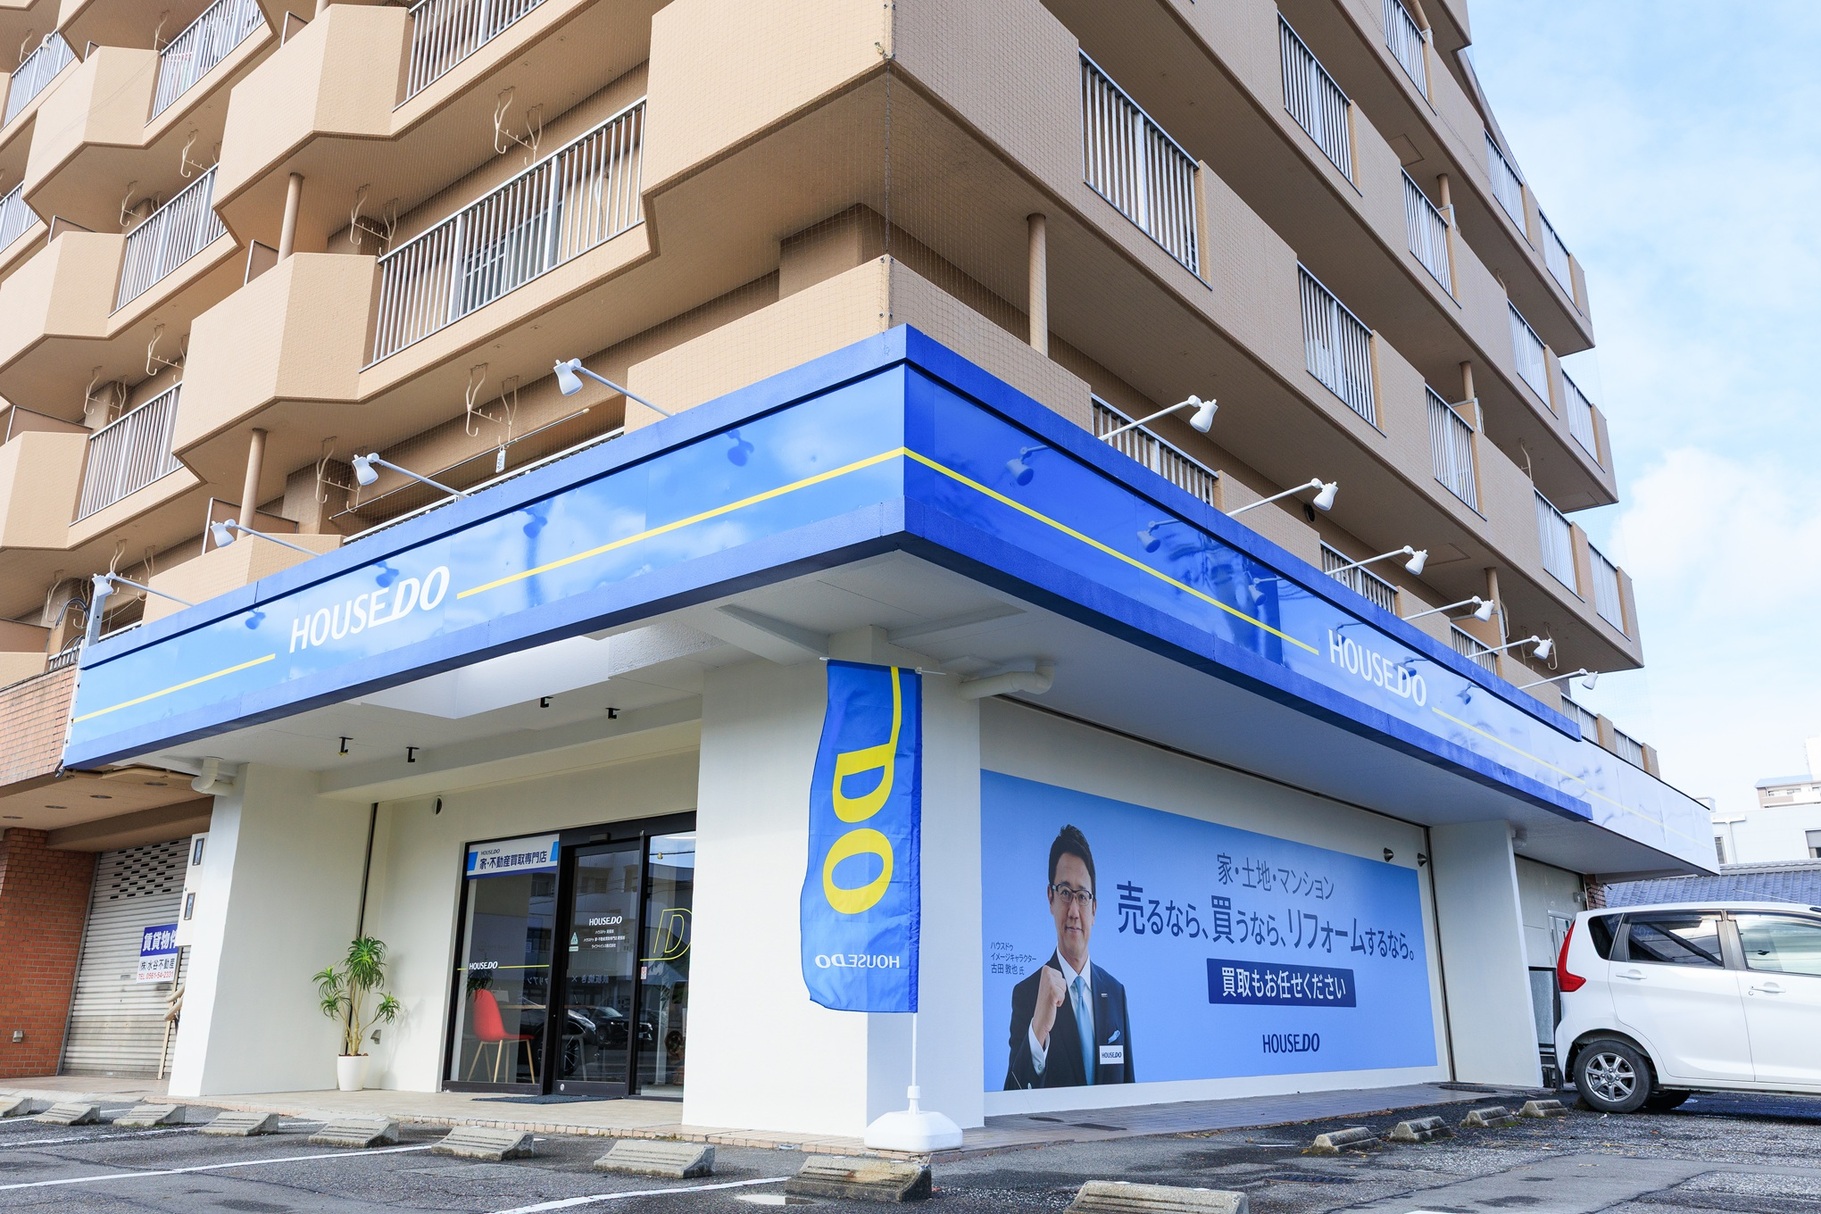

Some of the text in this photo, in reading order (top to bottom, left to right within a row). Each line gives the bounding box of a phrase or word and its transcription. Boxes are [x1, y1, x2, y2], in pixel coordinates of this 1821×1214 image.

[1216, 852, 1335, 901] 家・土地・マンション
[1116, 880, 1415, 961] 売るなら、買うなら、リフォームするなら。
[990, 952, 1037, 963] イメージキャラクター
[1221, 966, 1347, 1000] 買取もお任せください
